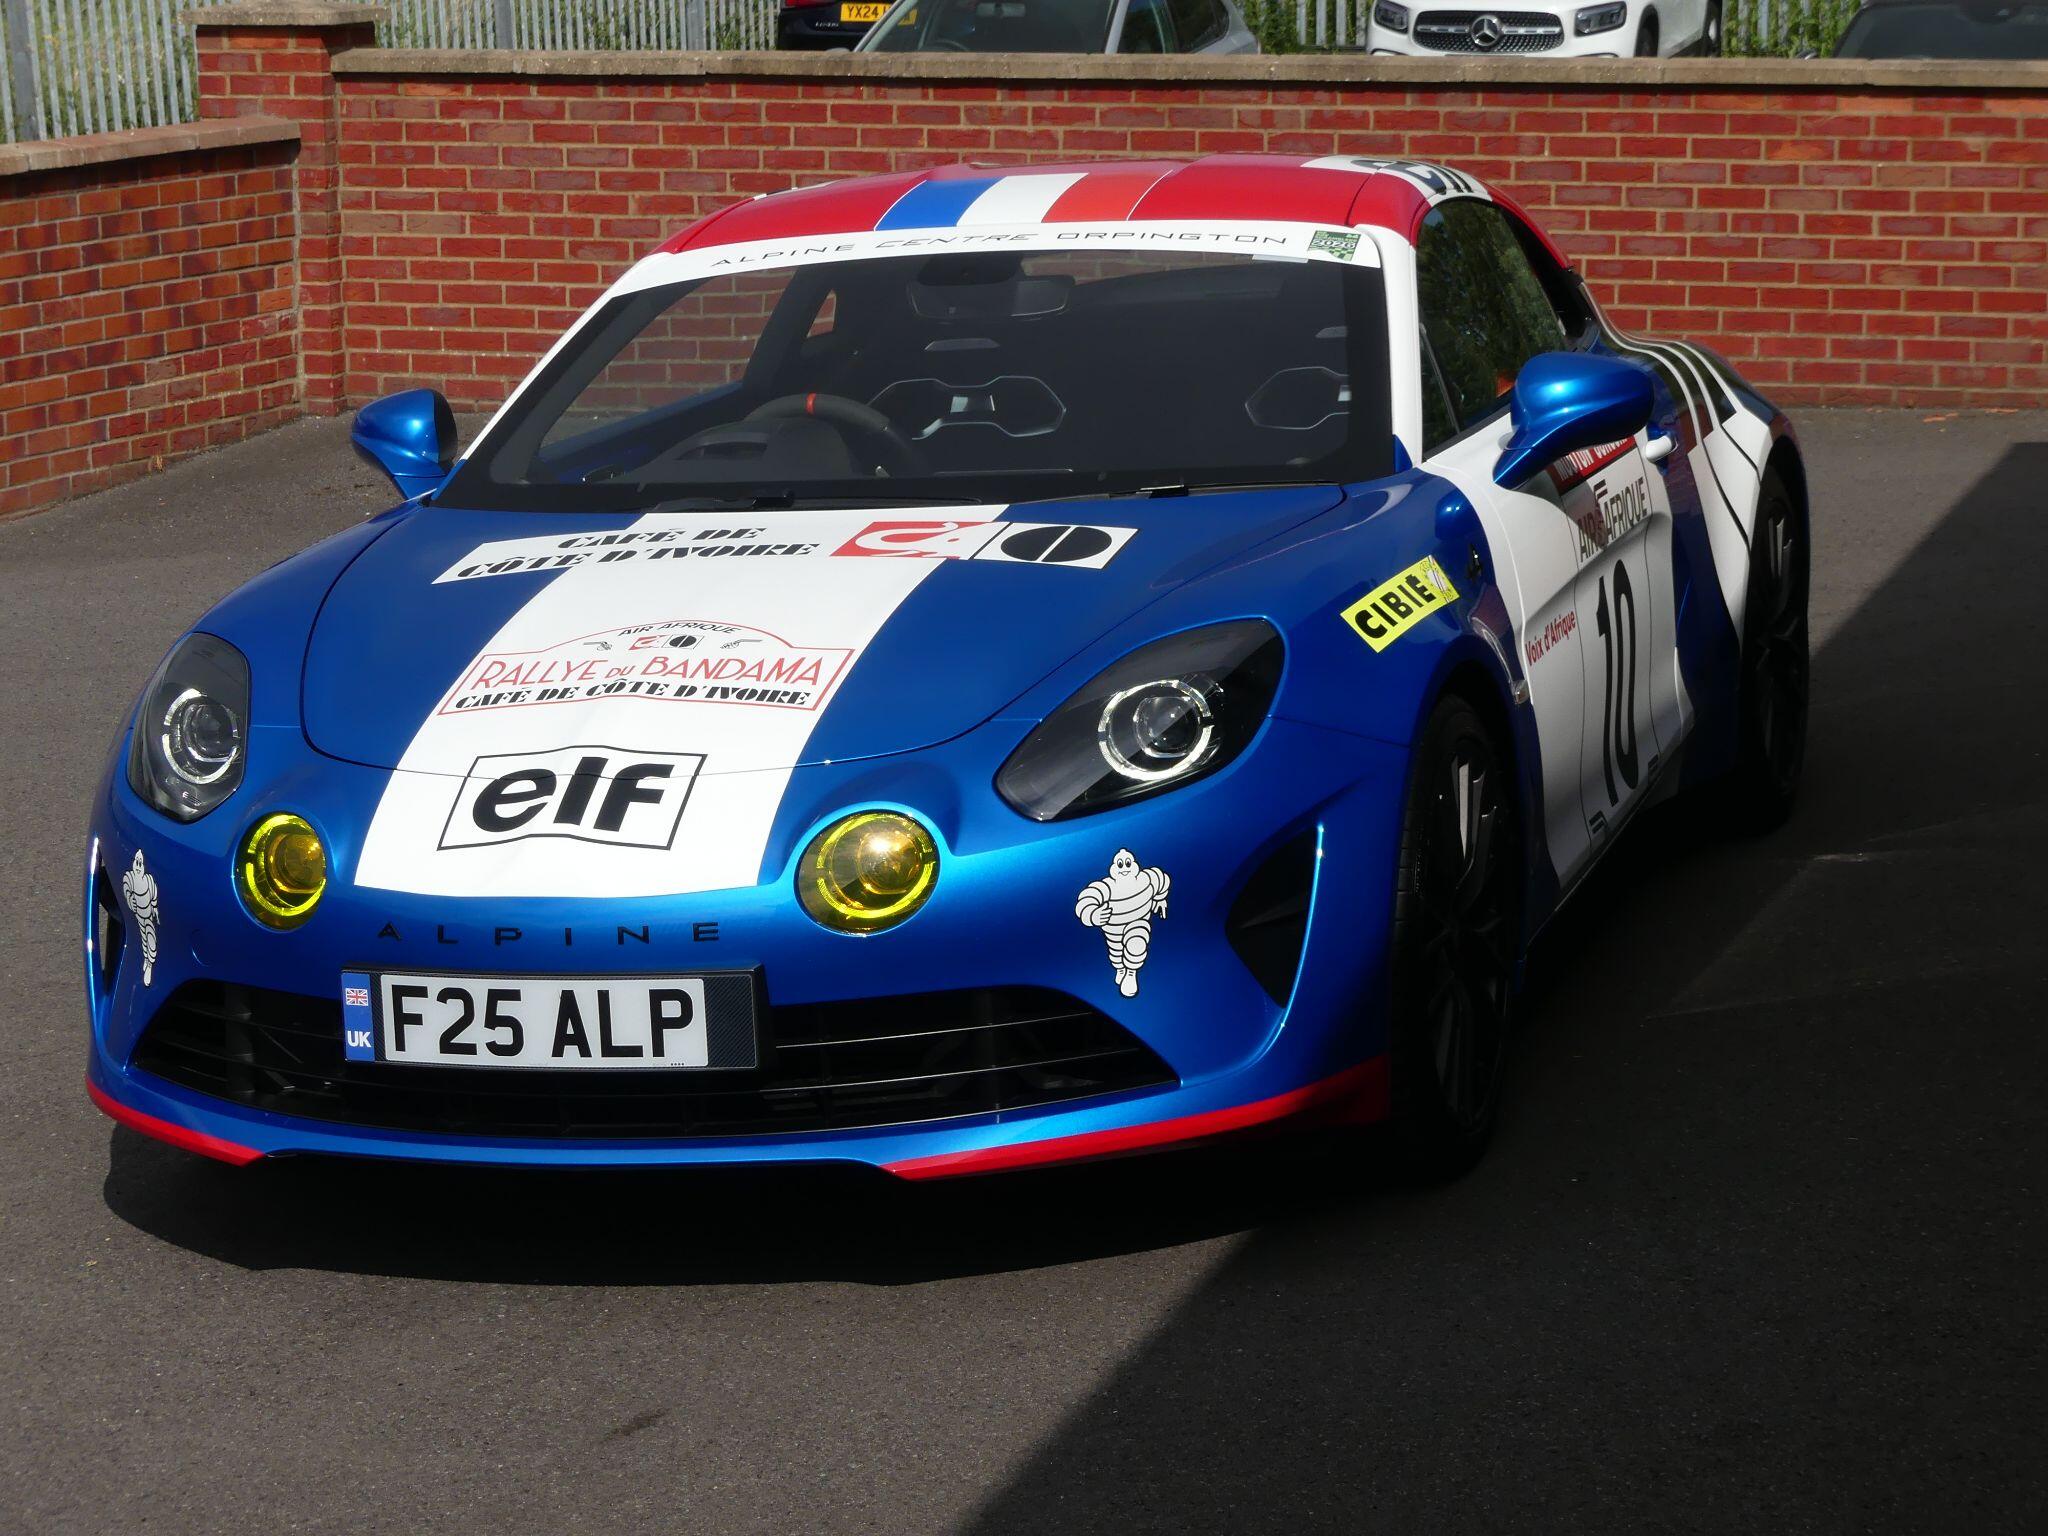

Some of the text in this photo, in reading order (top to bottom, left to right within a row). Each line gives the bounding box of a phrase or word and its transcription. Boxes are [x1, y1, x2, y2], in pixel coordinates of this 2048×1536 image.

[847, 5, 879, 18] YX24
[711, 232, 1287, 267] ALPINE CENTRE ORPINGTON
[1603, 477, 1648, 542] AFRIQUE
[557, 528, 767, 549] CAFÉ DE
[457, 543, 821, 579] CÔTE D'IVOIRE
[618, 621, 742, 637] AIR AFRIQUE
[1524, 610, 1577, 667] Voix d'Afrique
[470, 660, 609, 691] RALLYE
[640, 656, 825, 687] BANDAMA
[1596, 558, 1639, 807] 10
[455, 678, 812, 709] CAFÉ DE CÔTE D'IVOIRE
[471, 756, 676, 834] elf
[376, 921, 720, 947] ALPINE
[390, 984, 695, 1059] F25 ALP
[346, 1030, 372, 1049] UK
